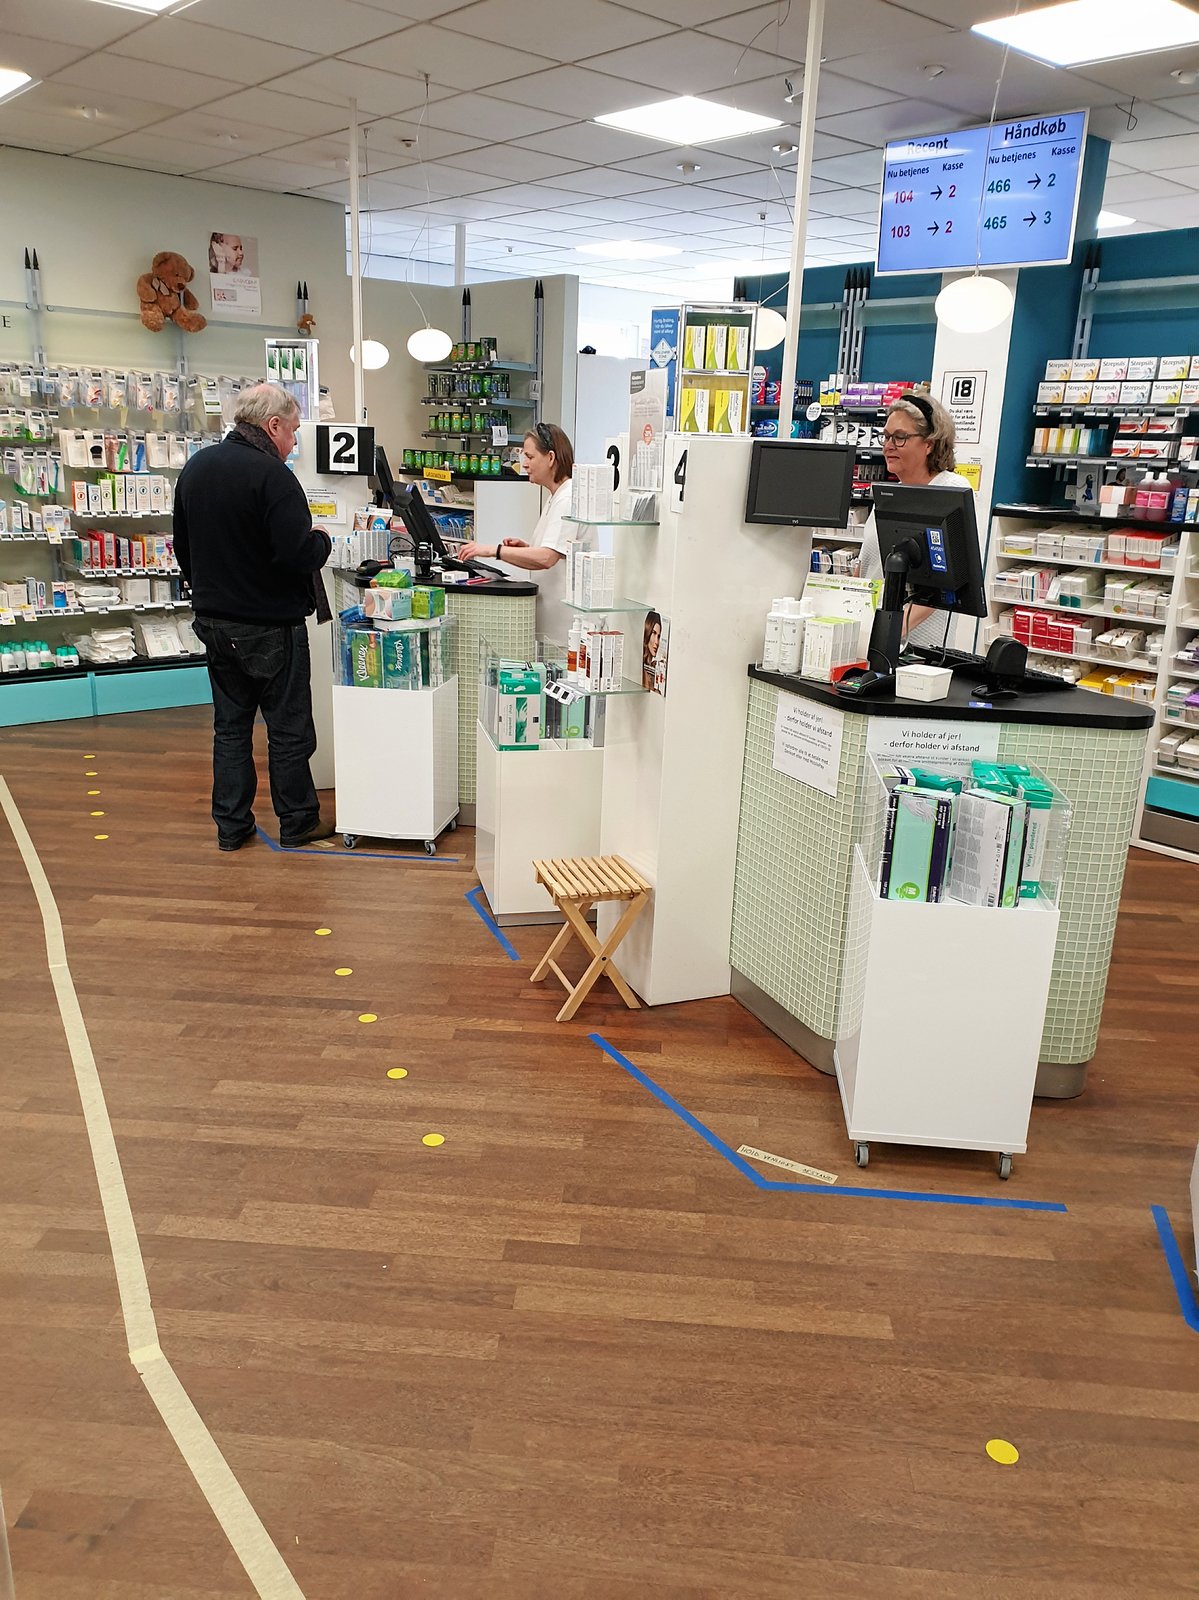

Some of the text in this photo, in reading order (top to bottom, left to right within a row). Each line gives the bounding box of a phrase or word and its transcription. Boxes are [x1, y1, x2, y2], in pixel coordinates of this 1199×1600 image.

[1004, 118, 1066, 141] Håndkøb
[907, 137, 949, 156] Recept
[989, 145, 1076, 165] Nu betjenes Kasse
[887, 161, 964, 179] Nu betjenes Kasse
[987, 173, 1056, 194] 466 2
[894, 185, 956, 204] 104 2
[891, 221, 952, 239] 103 2
[984, 211, 1052, 230] 465 3
[954, 380, 973, 397] 18
[333, 432, 355, 464] 2
[606, 445, 620, 491] 3
[674, 450, 688, 502] 4
[356, 643, 370, 681] Kleenex
[394, 639, 404, 672] Kleenex
[798, 709, 810, 719] holder
[787, 715, 799, 724] derfor
[800, 720, 812, 730] holder
[817, 727, 833, 738] afstand
[911, 731, 936, 739] holder
[947, 733, 962, 741] jer!
[915, 742, 941, 750] holder
[951, 744, 980, 753] afstand
[1025, 821, 1038, 868] Vinyl powdered
[741, 1146, 760, 1157] HOLD
[802, 1168, 833, 1181] AFSTAND
